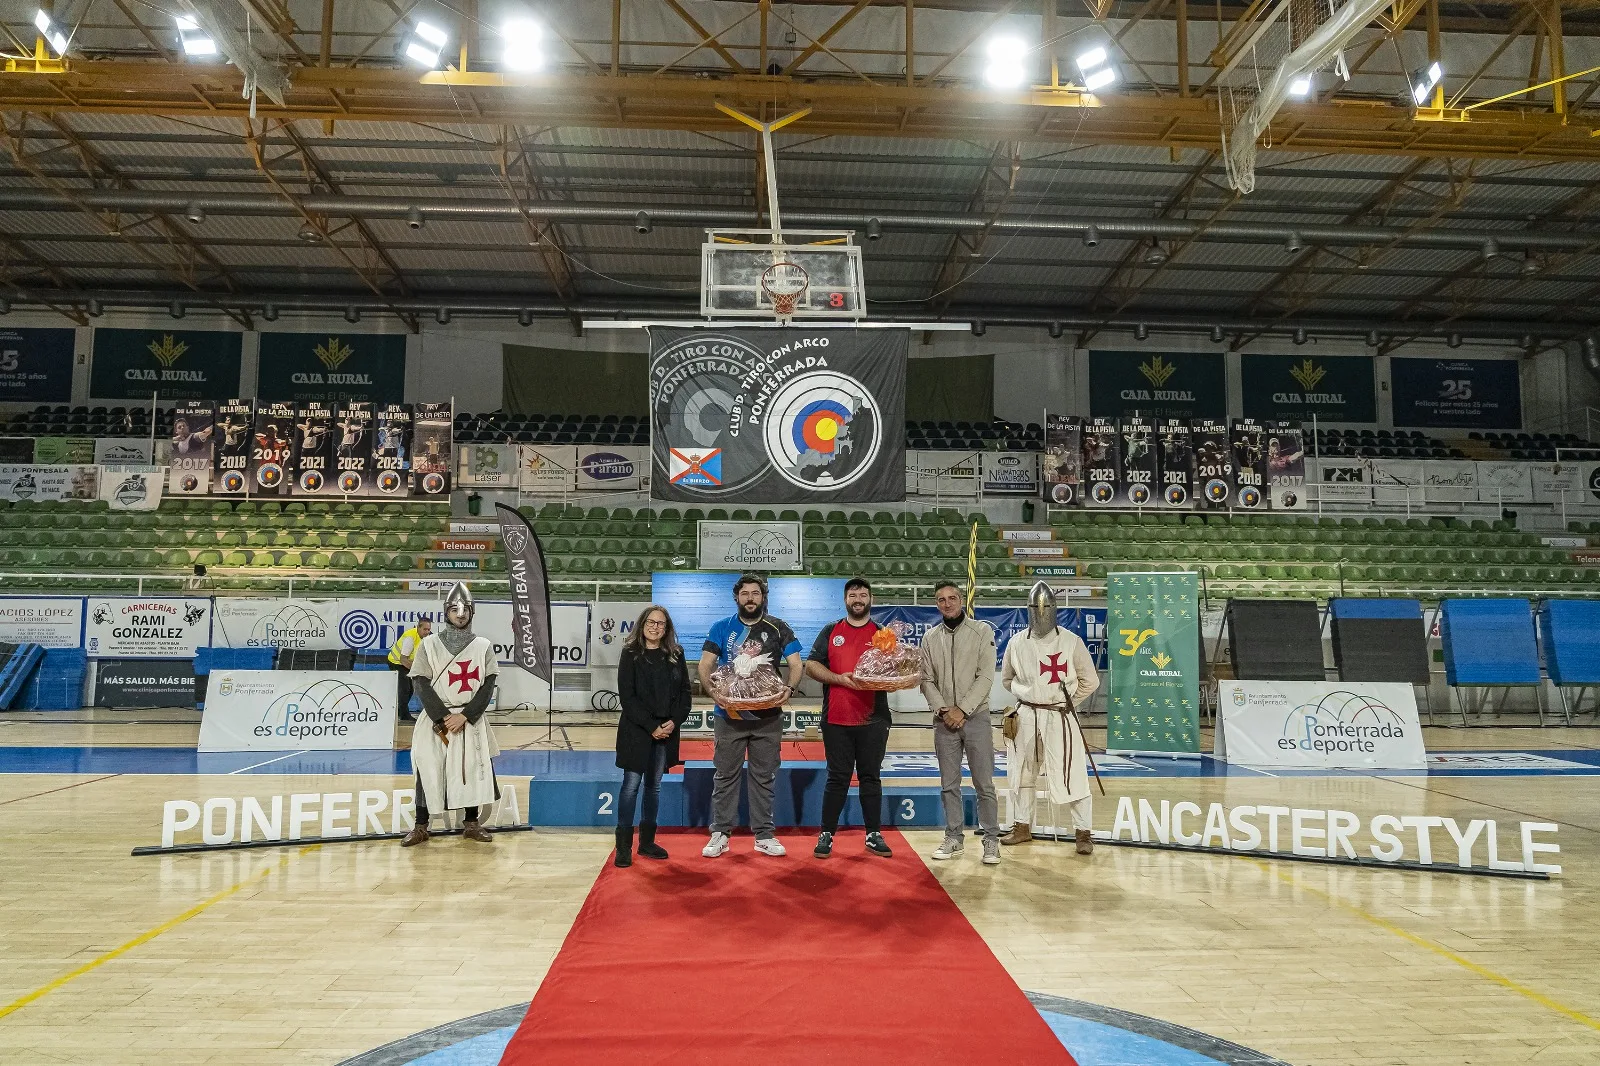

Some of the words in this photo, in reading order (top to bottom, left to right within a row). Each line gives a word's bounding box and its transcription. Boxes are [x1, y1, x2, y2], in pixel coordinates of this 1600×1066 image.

[670, 345, 707, 363] TIRO
[711, 344, 744, 360] CON
[124, 369, 158, 380] CAJA
[161, 370, 207, 382] RURAL
[292, 373, 324, 384] CAJA
[327, 373, 372, 385] RURAL
[730, 405, 742, 437] CLUB
[741, 362, 766, 390] TIRO
[766, 344, 791, 364] CON
[793, 338, 830, 351] ARCO
[749, 356, 828, 425] PONFERRADA
[1120, 390, 1151, 401] CAJA
[1153, 390, 1196, 401] RURAL
[1272, 393, 1303, 404] CAJA
[1305, 393, 1346, 404] RURAL
[235, 405, 250, 413] PISTA
[309, 402, 320, 410] REY
[350, 403, 361, 411] REY
[315, 409, 330, 417] PISTA
[355, 410, 371, 418] PISTA
[1100, 425, 1114, 433] PISTA
[1167, 426, 1174, 434] LA
[253, 448, 291, 461] 2019
[172, 457, 208, 470] 2017
[220, 456, 246, 469] 2018
[300, 456, 325, 469] 2021
[338, 457, 364, 470] 2022
[377, 456, 403, 469] 2023
[1090, 469, 1114, 481] 2023
[1200, 464, 1232, 476] 2019
[1127, 471, 1151, 482] 2022
[1164, 471, 1187, 483] 2021
[1238, 472, 1262, 485] 2018
[1273, 475, 1304, 487] 2017
[442, 541, 485, 550] Telenauto
[741, 543, 793, 556] Ponferrada
[736, 554, 777, 564] deporte
[0, 608, 33, 617] ACIOS
[39, 607, 73, 617] LÓPEZ
[121, 603, 178, 615] CARNICERÍAS
[131, 615, 165, 626] RAMI
[112, 627, 183, 639] GONZALEZ
[265, 623, 326, 637] Ponferrada
[518, 604, 536, 668] GARAJE
[246, 638, 259, 647] es
[261, 637, 306, 651] deporte
[104, 676, 124, 685] MÁS
[125, 677, 158, 685] SALUD.
[159, 676, 179, 685] MÁS
[181, 677, 195, 685] BIE
[286, 703, 379, 723] Ponferrada
[253, 725, 272, 737] es
[275, 722, 348, 740] deporte
[1305, 715, 1404, 738] Ponferrada
[1278, 738, 1297, 750] es
[1299, 737, 1375, 755] deporte
[598, 792, 613, 815] 2
[901, 798, 915, 820] 3
[1370, 814, 1562, 874] STYLE
